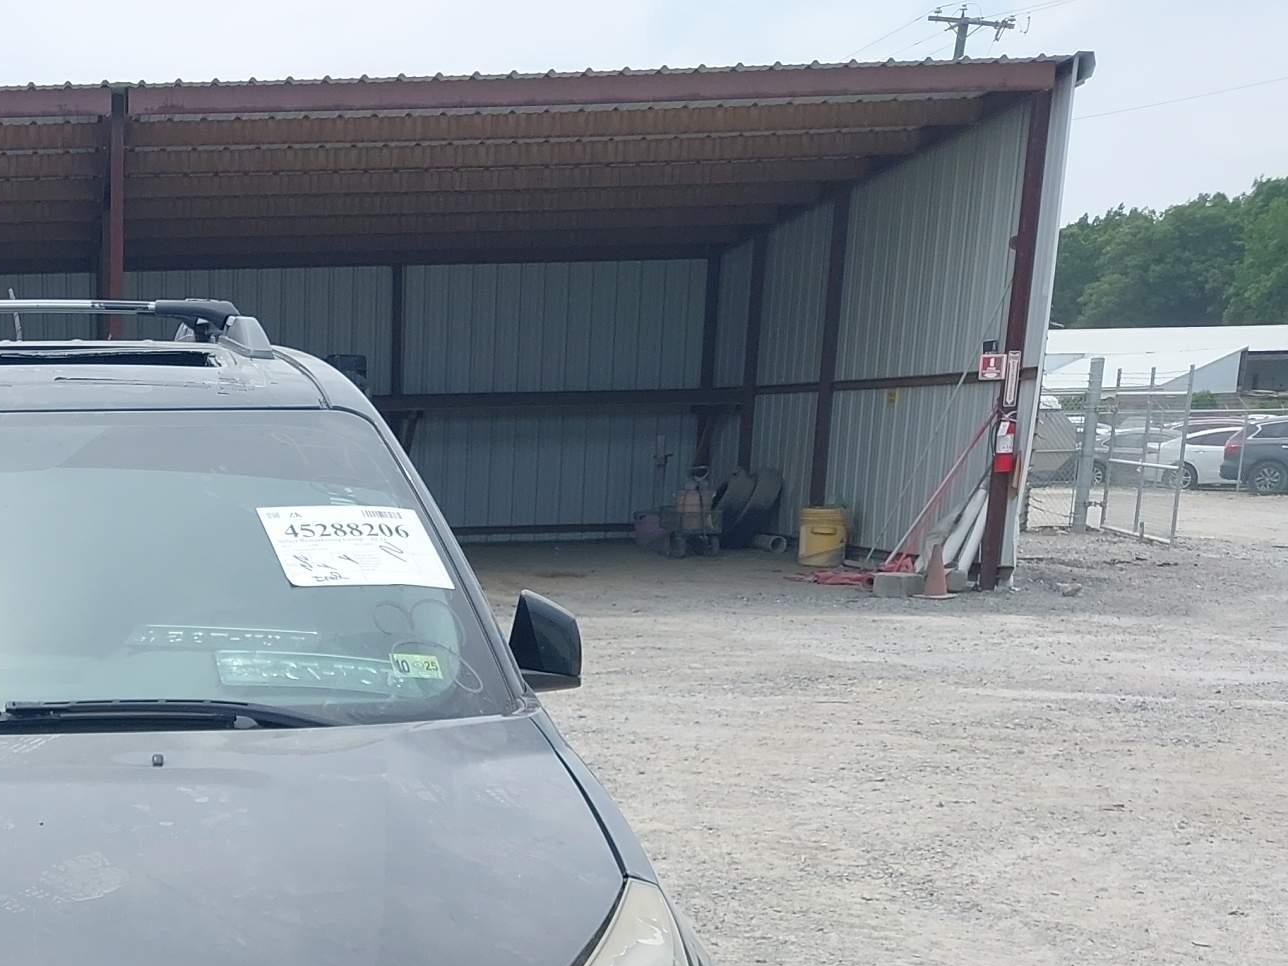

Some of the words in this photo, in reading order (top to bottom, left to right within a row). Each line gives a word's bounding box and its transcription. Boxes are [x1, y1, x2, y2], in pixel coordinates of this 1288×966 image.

[284, 522, 410, 539] 45288206
[396, 659, 410, 673] 10
[423, 660, 439, 672] 25
